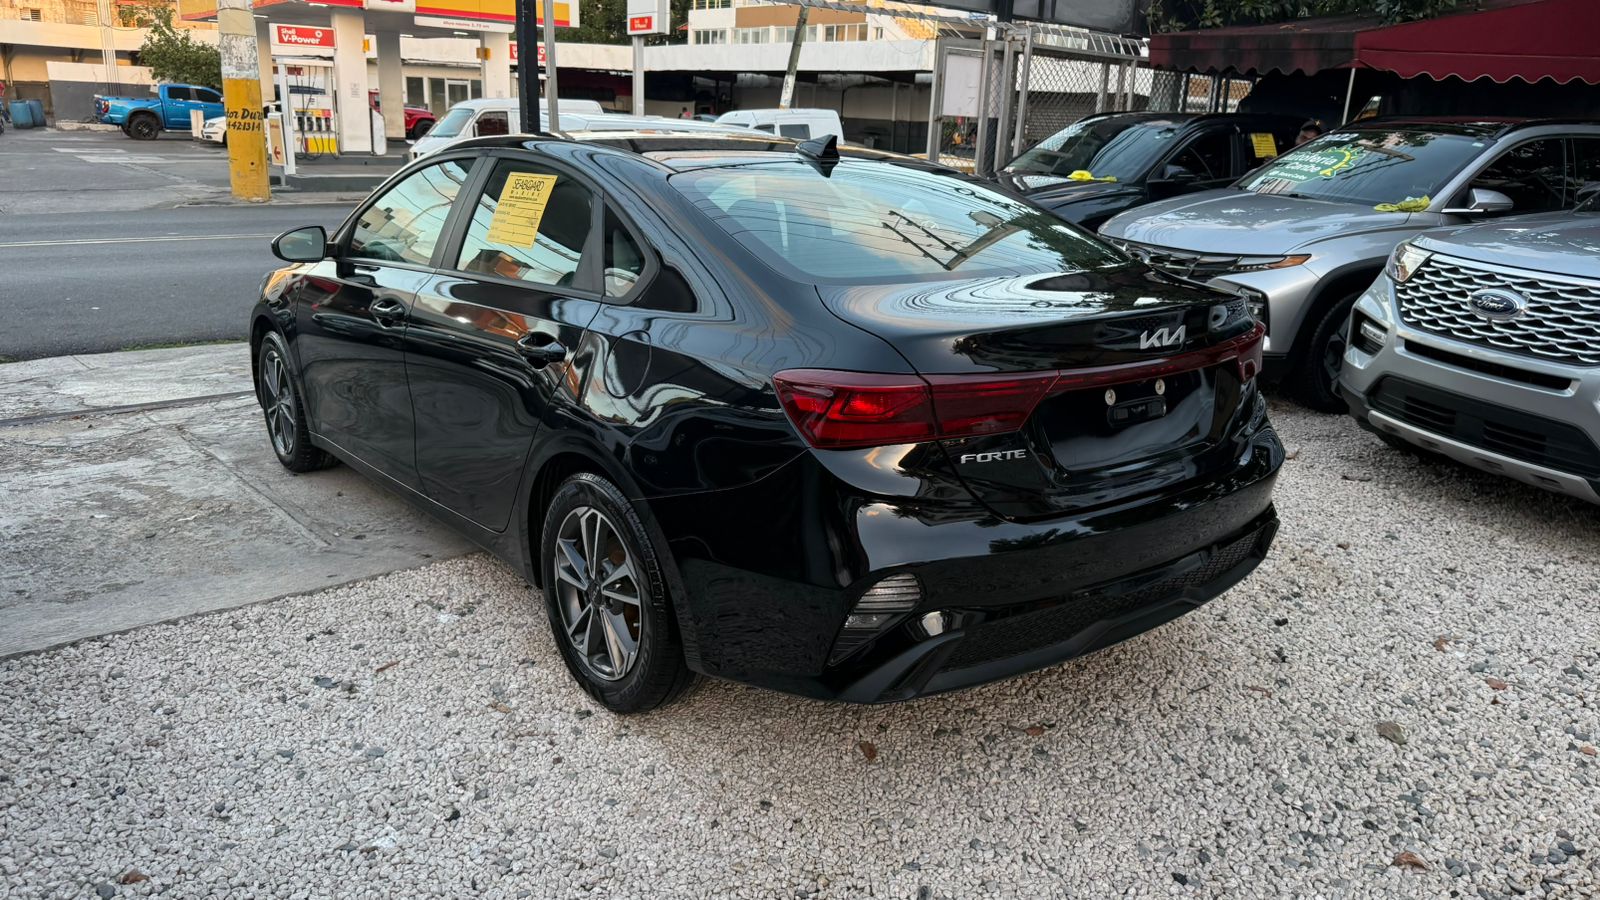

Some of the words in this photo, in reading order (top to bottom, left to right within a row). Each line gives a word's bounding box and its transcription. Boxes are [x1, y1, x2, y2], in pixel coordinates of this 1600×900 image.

[282, 35, 321, 45] V-Power
[513, 179, 545, 191] SEABOARD
[1477, 295, 1507, 310] Ford
[1140, 325, 1186, 350] KIA
[960, 448, 1027, 464] FORTE
